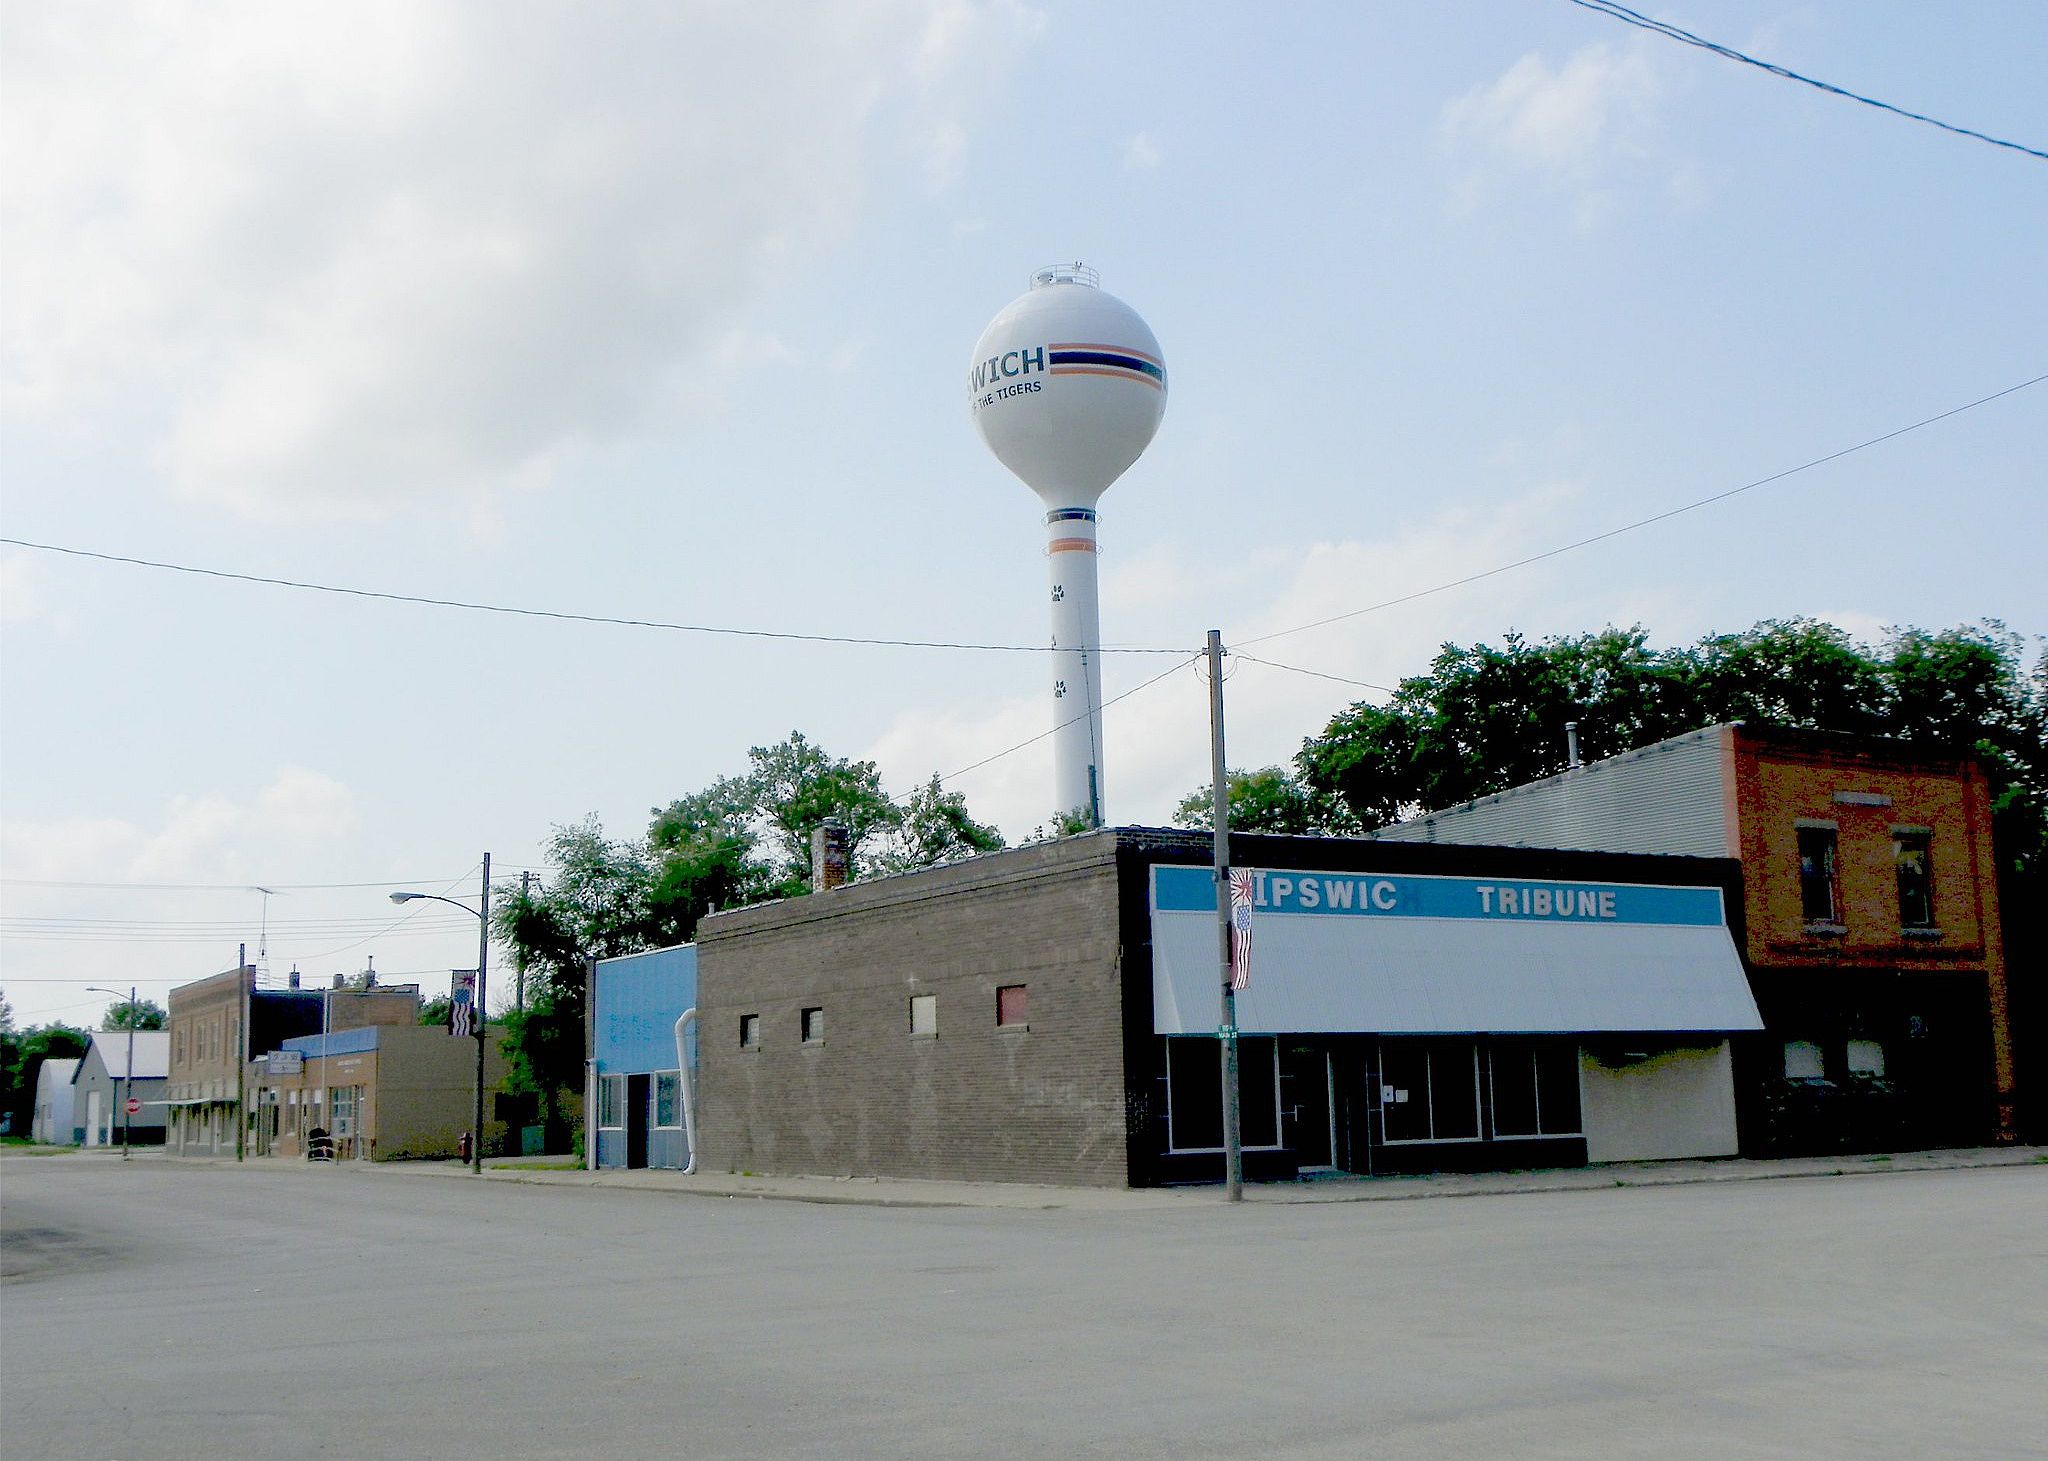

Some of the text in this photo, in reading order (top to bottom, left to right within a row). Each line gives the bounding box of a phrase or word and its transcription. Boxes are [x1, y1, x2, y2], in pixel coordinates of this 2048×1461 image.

[978, 394, 994, 409] THE
[996, 381, 1042, 401] TIGERS
[1476, 886, 1617, 918] TRIBUNE
